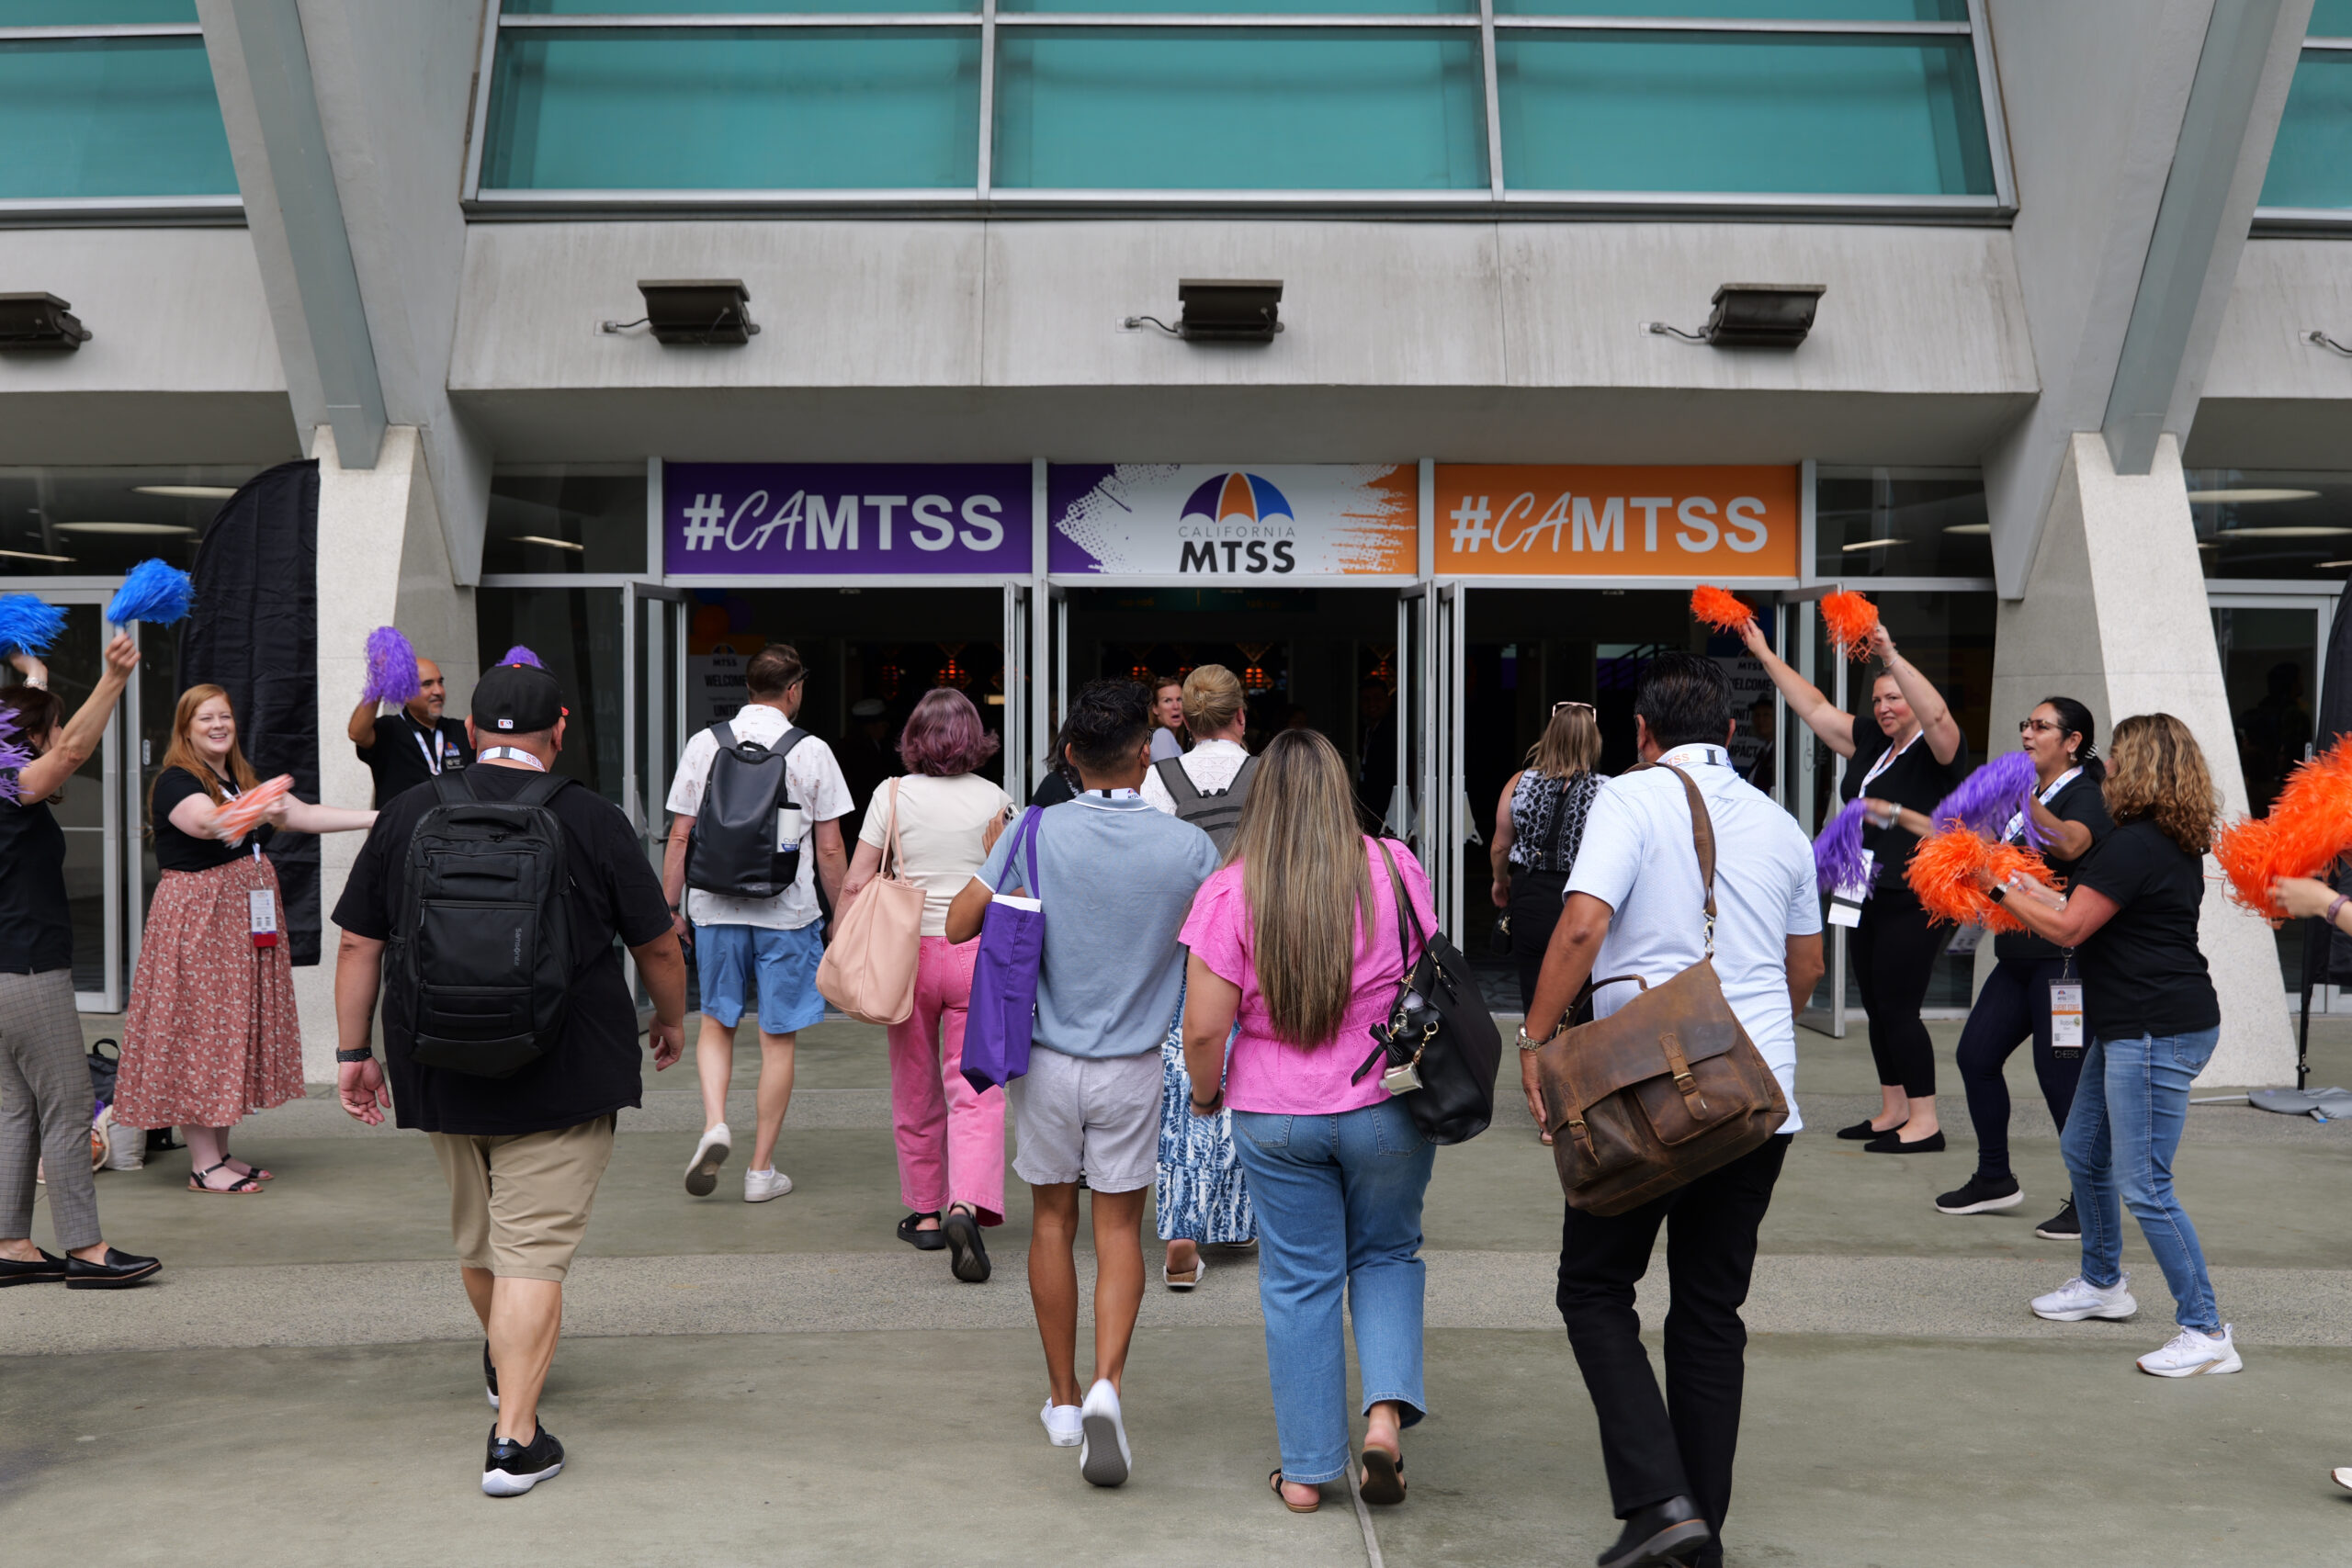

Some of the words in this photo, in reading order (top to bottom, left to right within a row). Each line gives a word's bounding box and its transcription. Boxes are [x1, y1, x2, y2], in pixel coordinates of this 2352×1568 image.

[683, 490, 1005, 552] #CAMTSS
[1178, 525, 1296, 538] CALIFORNIA
[1450, 491, 1769, 553] #CAMTSS
[1179, 540, 1296, 574] MTSS
[713, 658, 738, 667] MTSS
